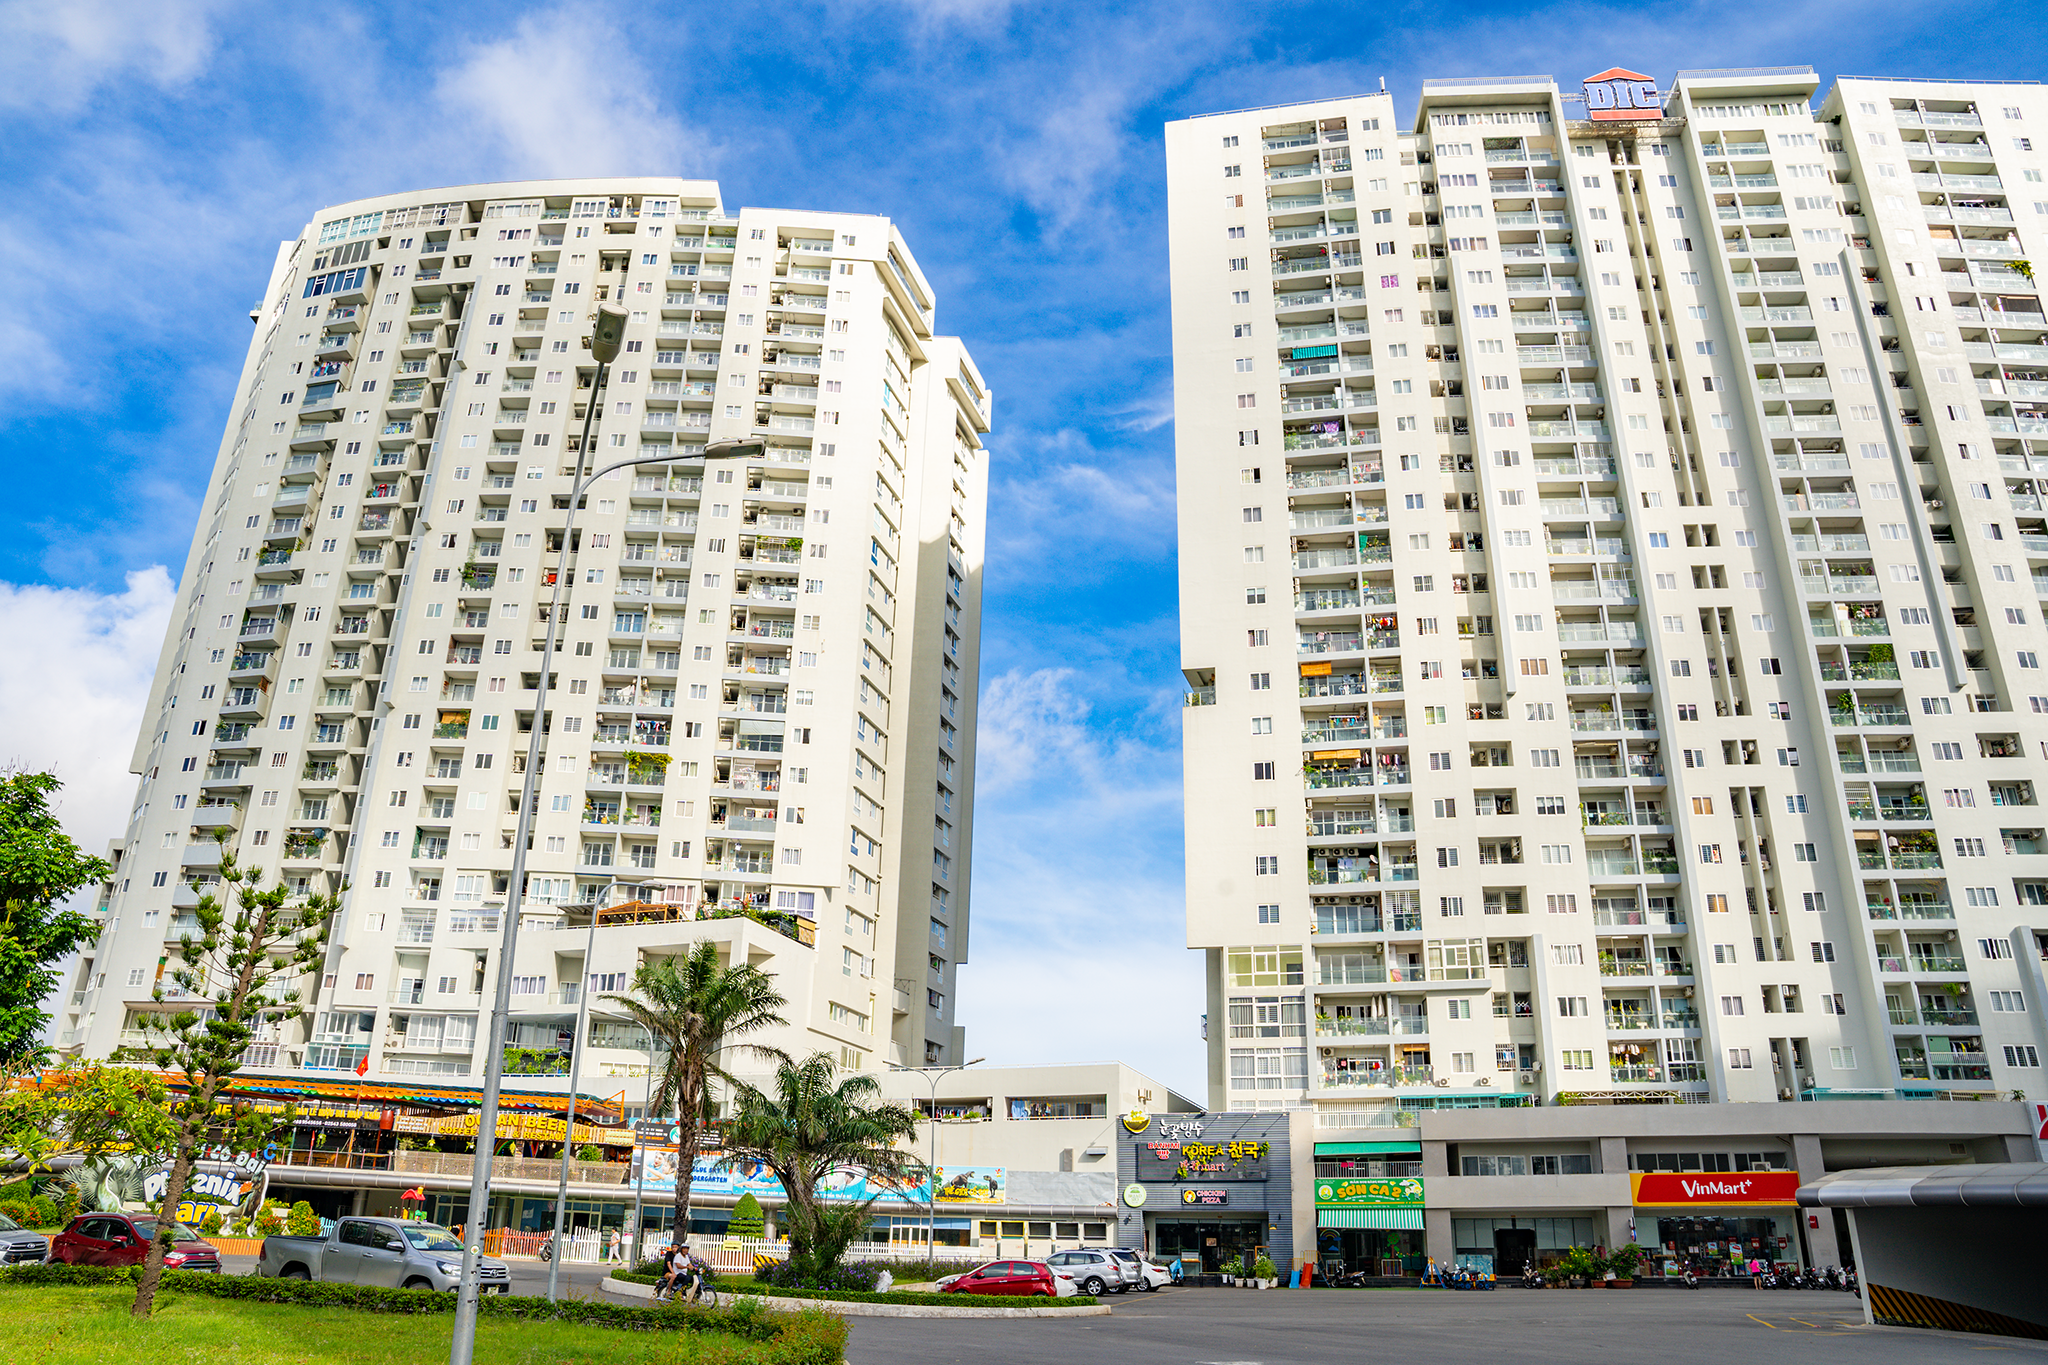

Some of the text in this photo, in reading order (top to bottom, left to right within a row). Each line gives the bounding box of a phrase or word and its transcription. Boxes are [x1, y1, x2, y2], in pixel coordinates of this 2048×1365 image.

[1584, 82, 1660, 109] DIC
[439, 1125, 477, 1136] COFFEE
[512, 1130, 520, 1138] &
[465, 1114, 519, 1127] OCAN
[526, 1115, 568, 1133] BEER
[1182, 1141, 1260, 1159] KOREA 천국
[144, 1169, 241, 1207] Phenix
[1337, 1184, 1402, 1198] SƠN CA 2
